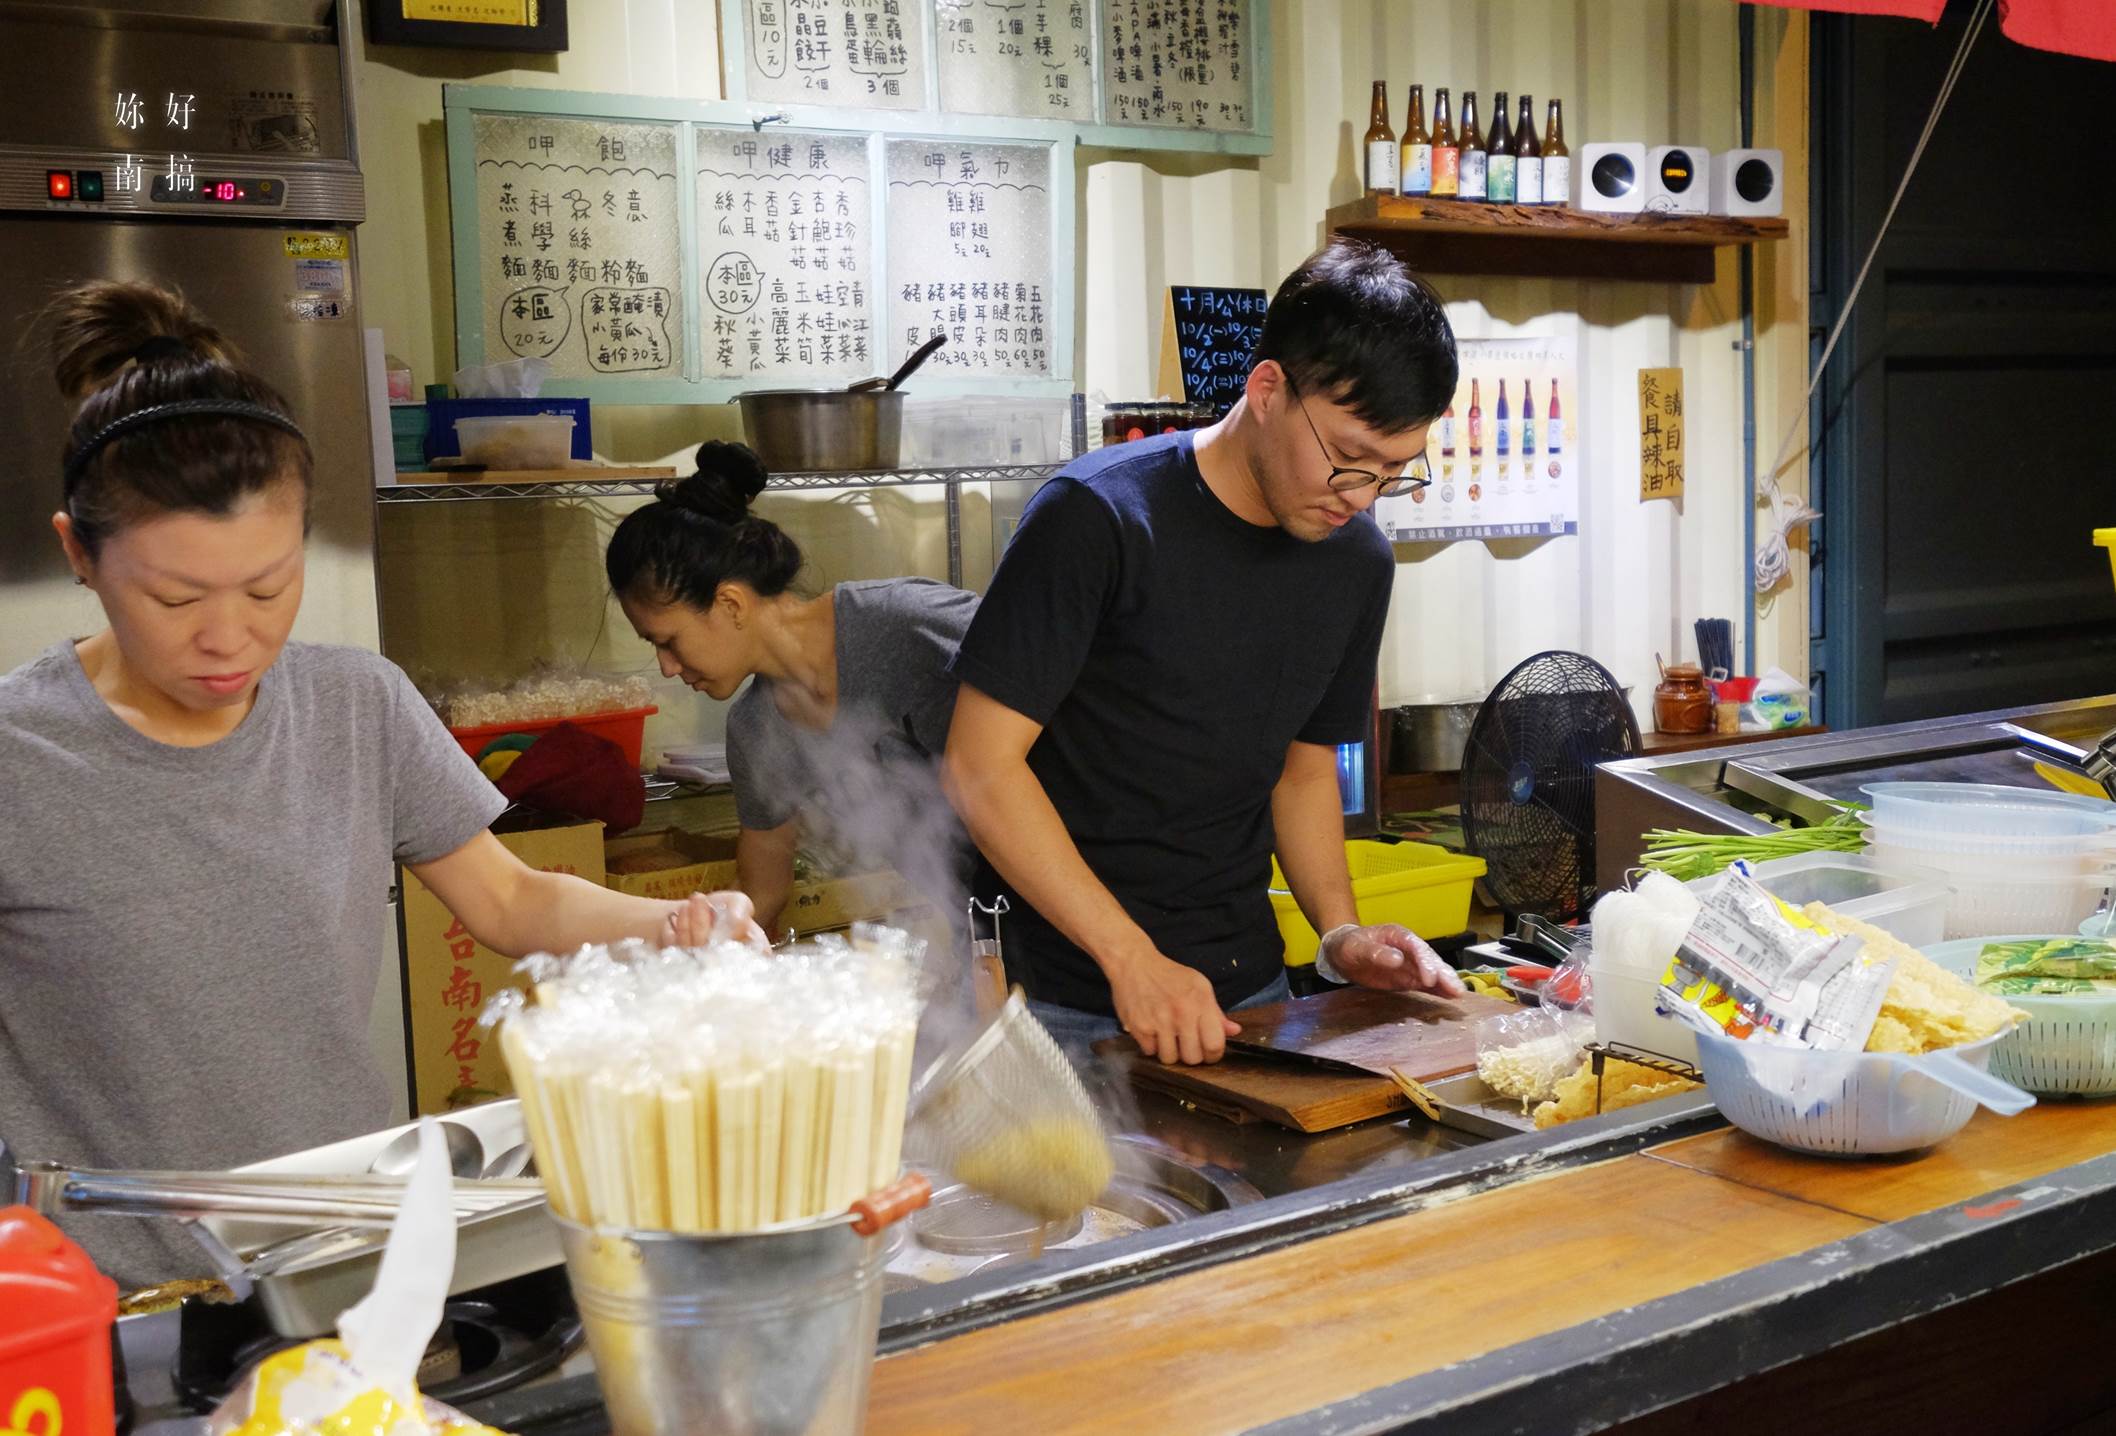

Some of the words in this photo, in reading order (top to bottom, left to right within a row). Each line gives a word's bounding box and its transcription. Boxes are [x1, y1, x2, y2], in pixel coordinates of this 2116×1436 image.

[866, 80, 901, 96] 3個
[1044, 74, 1069, 89] 1個
[714, 190, 736, 237] 絲瓜
[742, 190, 758, 238] 木耳
[763, 190, 781, 243] 香菇
[788, 191, 809, 270] 金針菇
[834, 190, 857, 272] 秀珍菇
[718, 261, 753, 286] 本區
[718, 288, 753, 304] 30元
[514, 332, 555, 346] 20元
